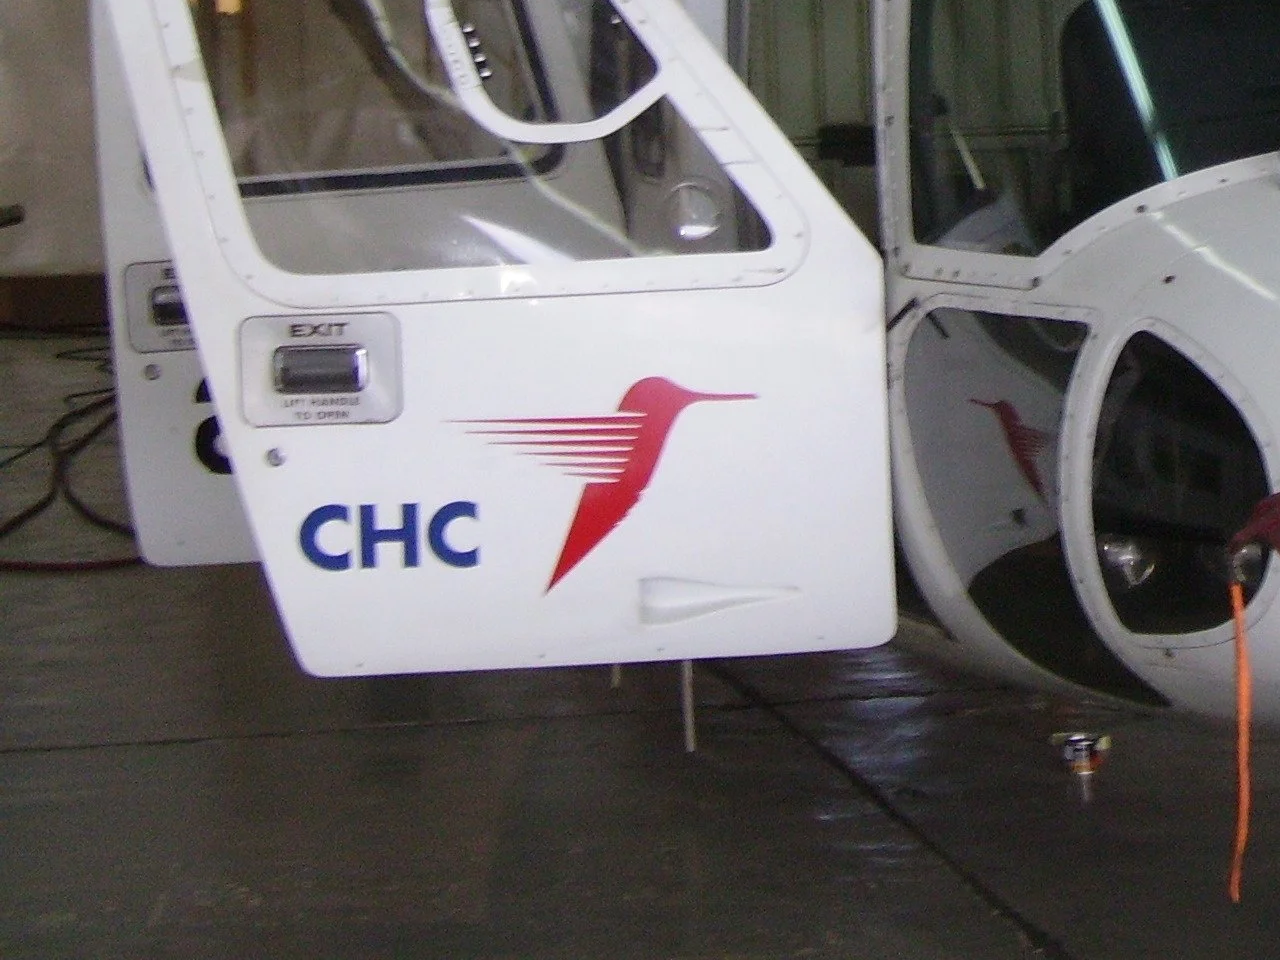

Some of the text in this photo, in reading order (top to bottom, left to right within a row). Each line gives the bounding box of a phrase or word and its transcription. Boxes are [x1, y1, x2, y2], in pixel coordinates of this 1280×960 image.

[289, 322, 350, 338] EXIT
[295, 411, 311, 420] TO
[299, 501, 480, 571] CHC
